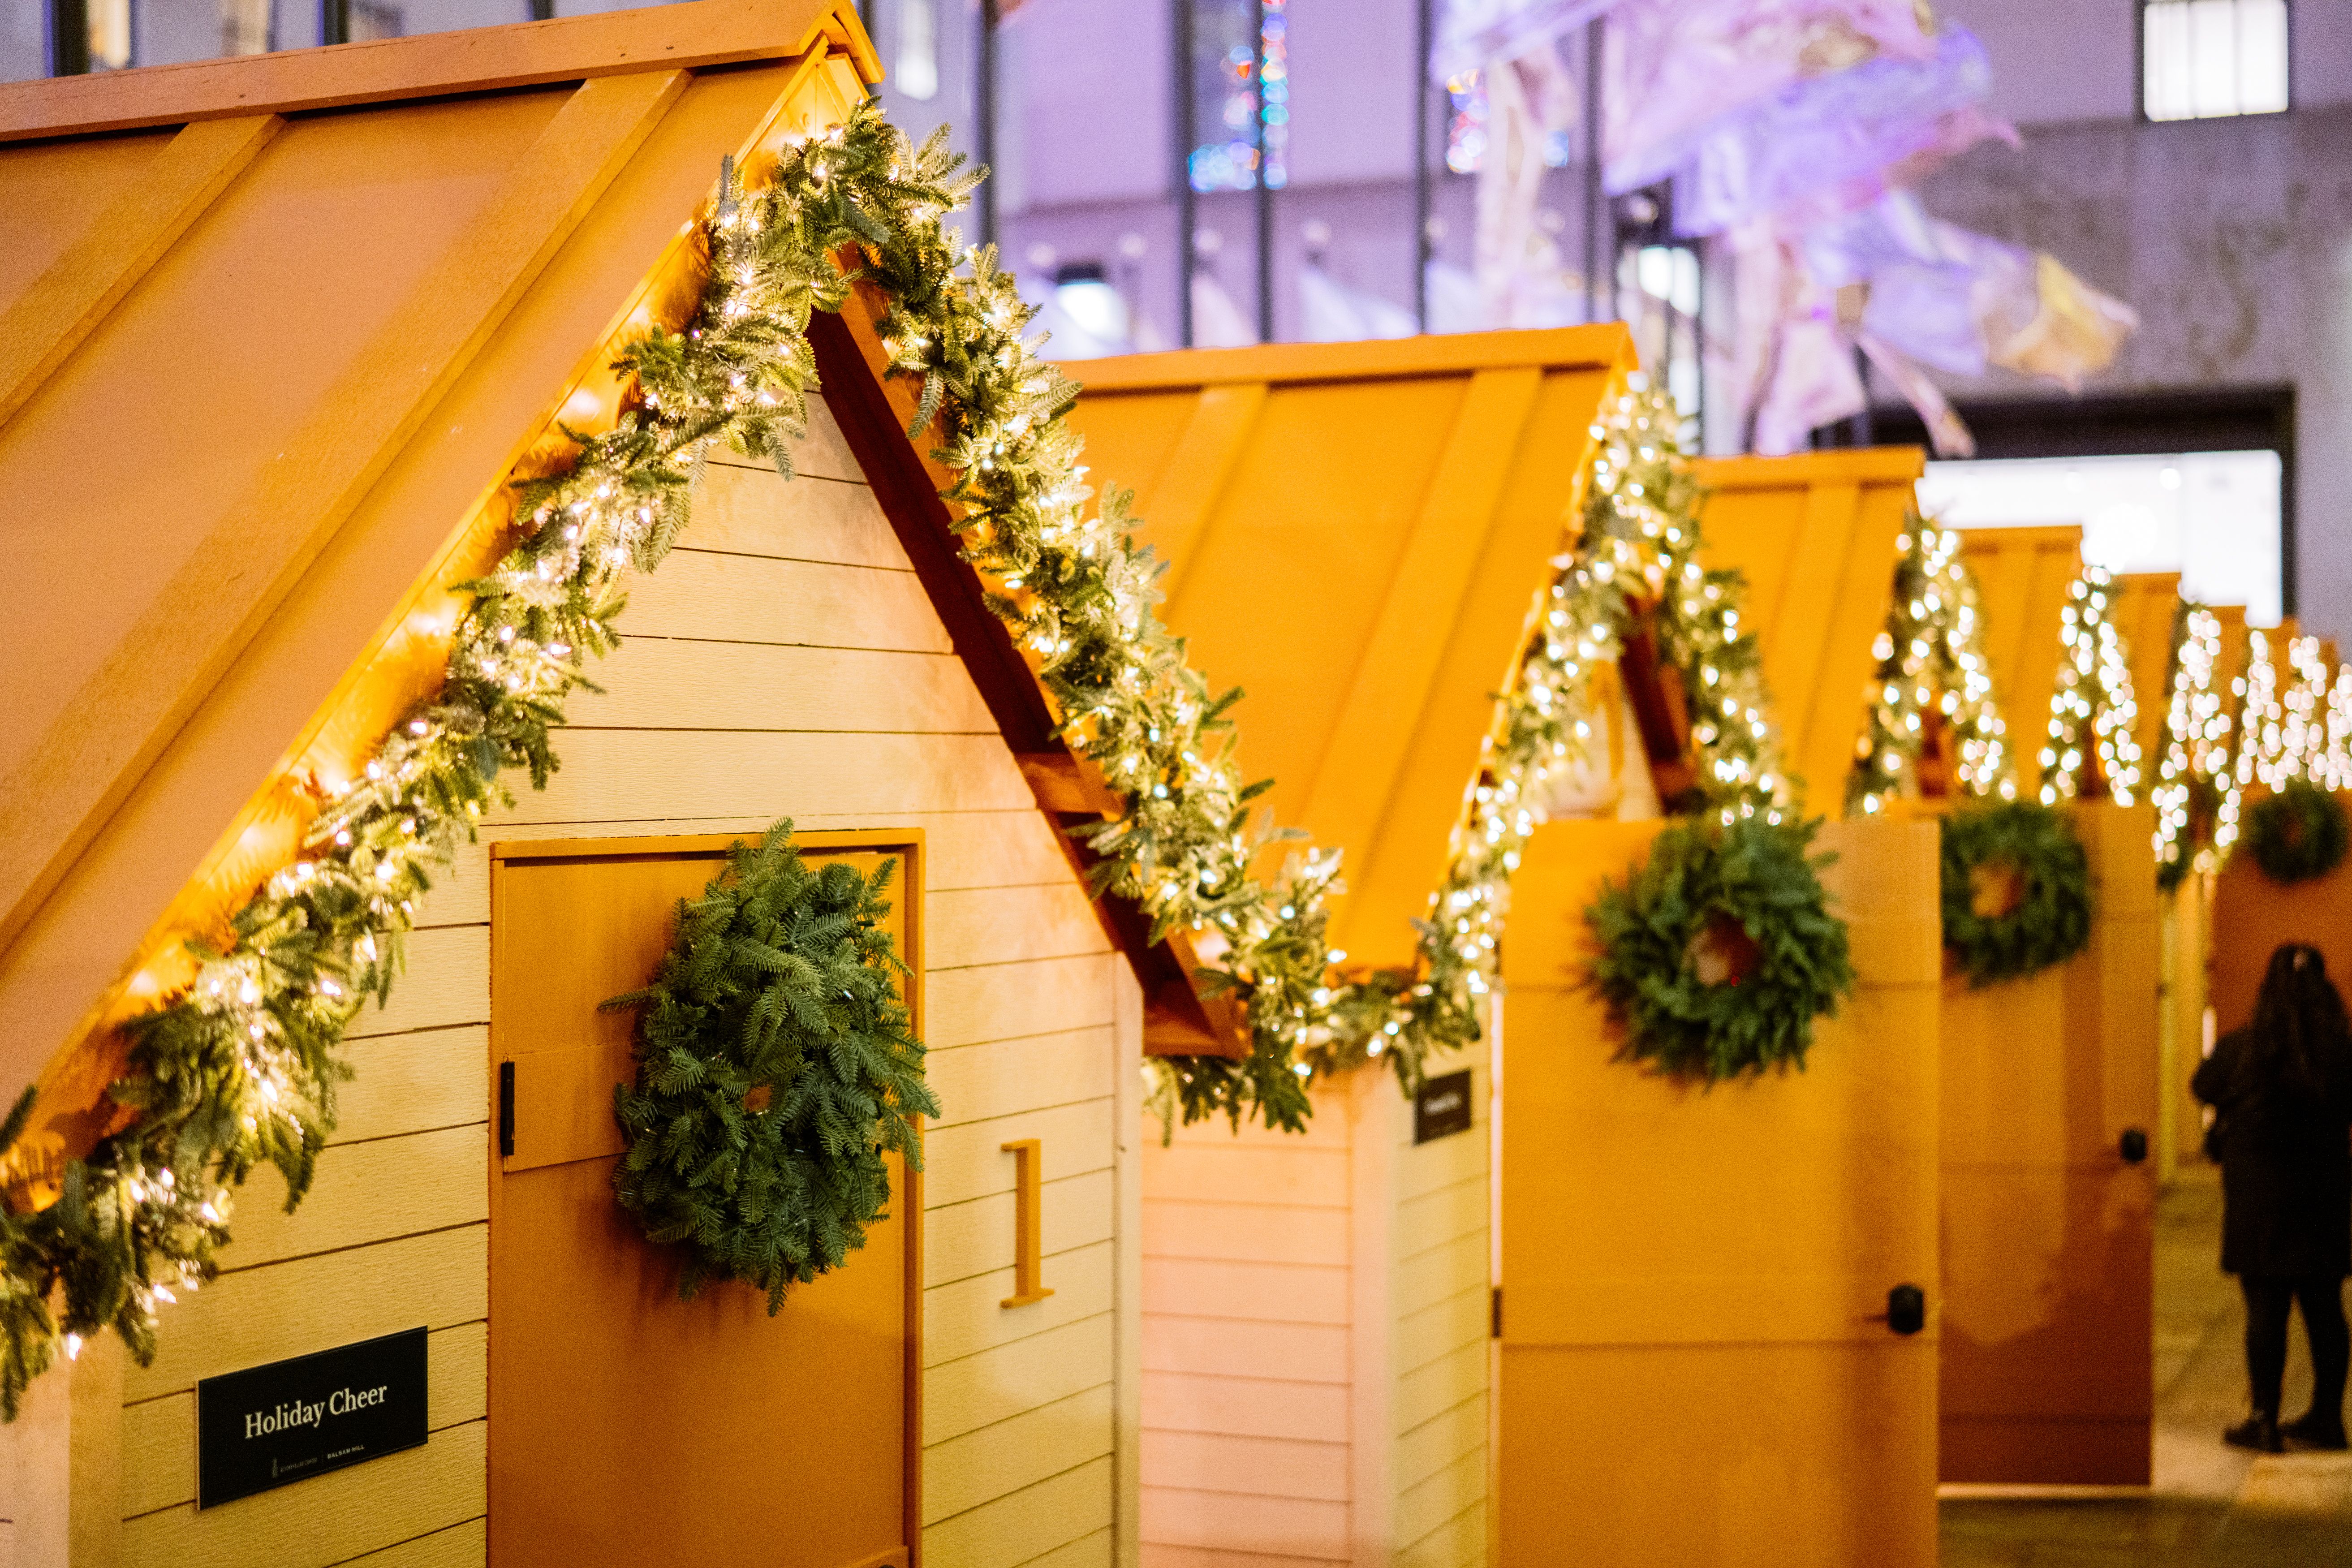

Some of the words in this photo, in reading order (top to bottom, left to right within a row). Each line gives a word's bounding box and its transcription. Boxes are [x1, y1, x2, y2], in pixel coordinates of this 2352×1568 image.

[245, 1400, 325, 1439] Holiday
[329, 1386, 387, 1415] Cheer
[327, 1447, 351, 1459] BALSAM
[352, 1444, 365, 1452] HILL
